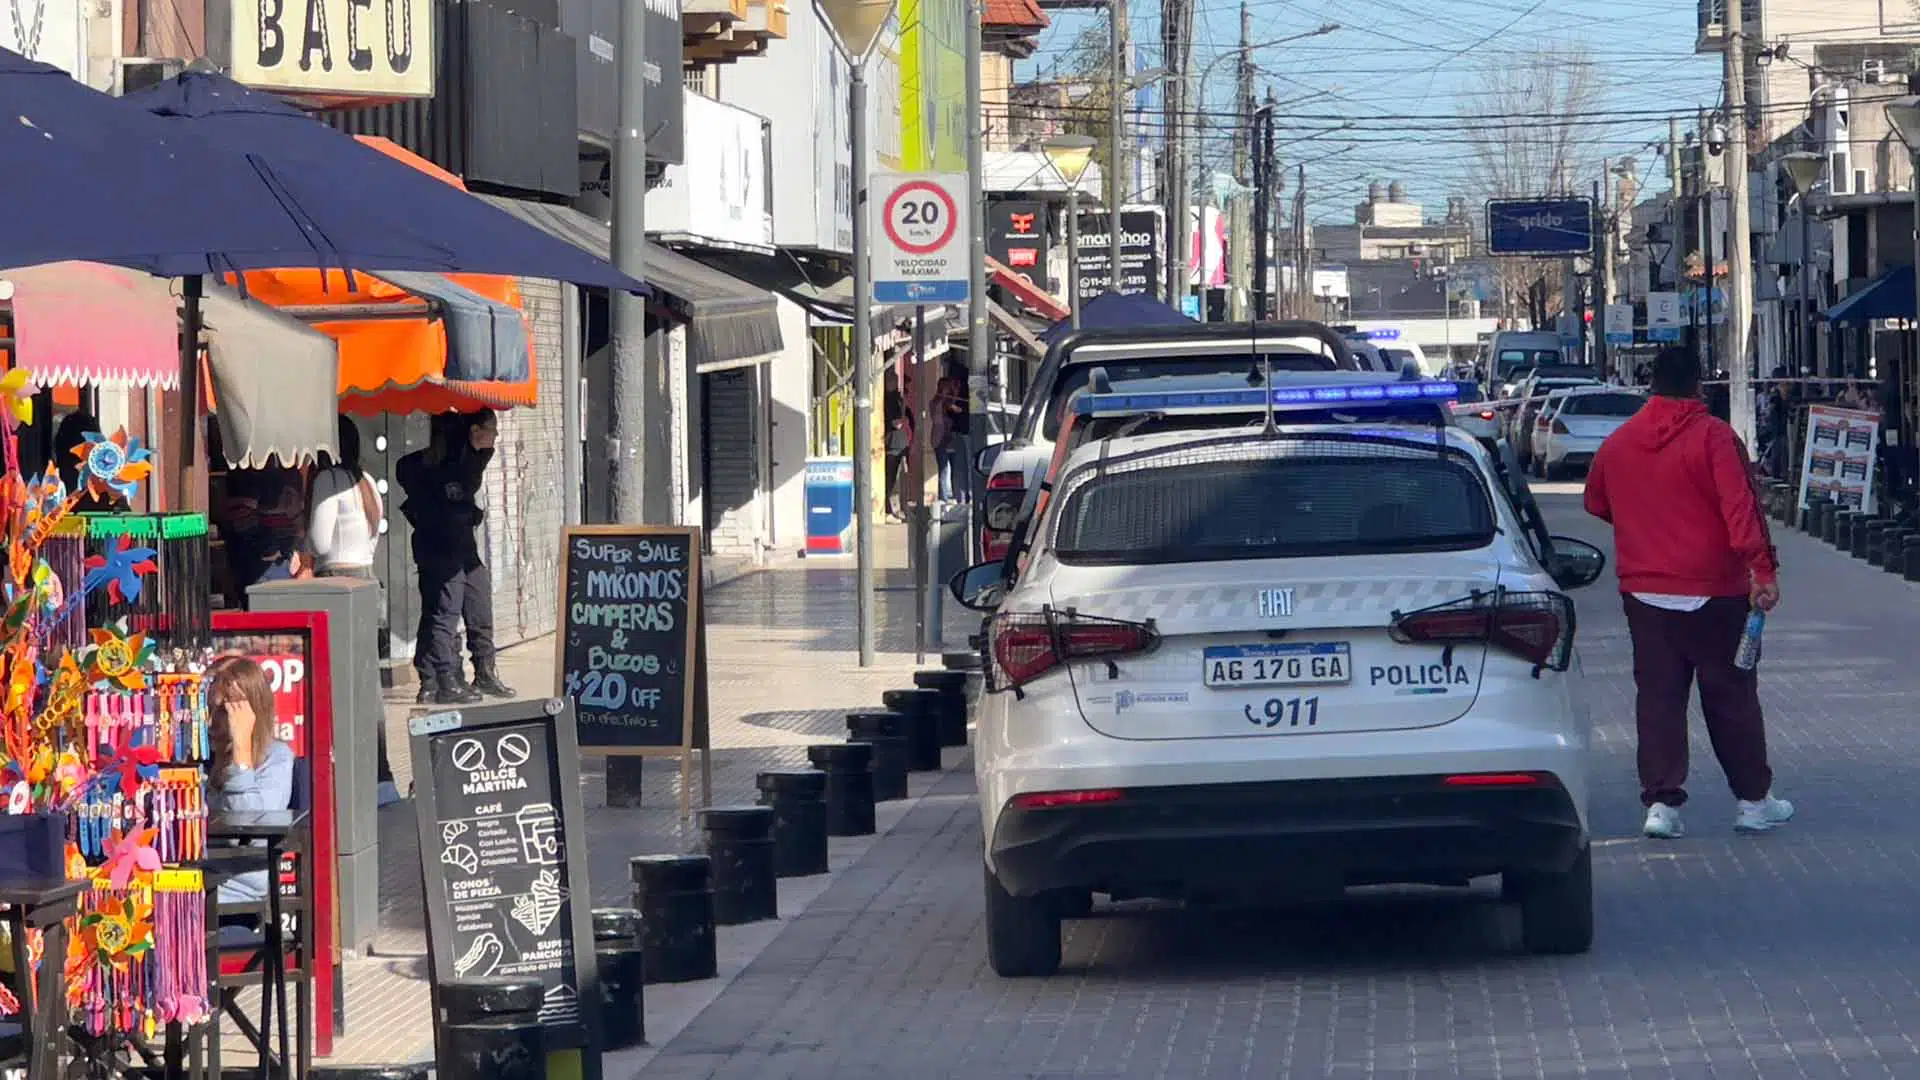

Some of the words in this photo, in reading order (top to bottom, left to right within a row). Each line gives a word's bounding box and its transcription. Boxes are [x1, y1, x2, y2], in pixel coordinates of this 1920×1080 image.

[902, 201, 939, 225] 20
[894, 259, 947, 267] VELOCIDAD
[902, 266, 940, 276] MÁXIMA
[638, 540, 681, 563] SALE
[587, 569, 682, 599] MYKONOS
[1259, 588, 1294, 617] FIAT
[571, 602, 675, 632] CAMPERAS
[610, 629, 629, 650] &
[1212, 660, 1243, 682] AG
[1253, 659, 1301, 680] 170
[1311, 657, 1343, 678] GA
[631, 687, 662, 709] OFF
[1264, 696, 1319, 728] 911
[470, 768, 517, 783] DULCE
[463, 778, 528, 795] MARTINA
[475, 802, 502, 815] CAFÉ
[452, 878, 490, 891] CONOS
[453, 889, 468, 899] DE
[470, 886, 502, 898] PIZZA
